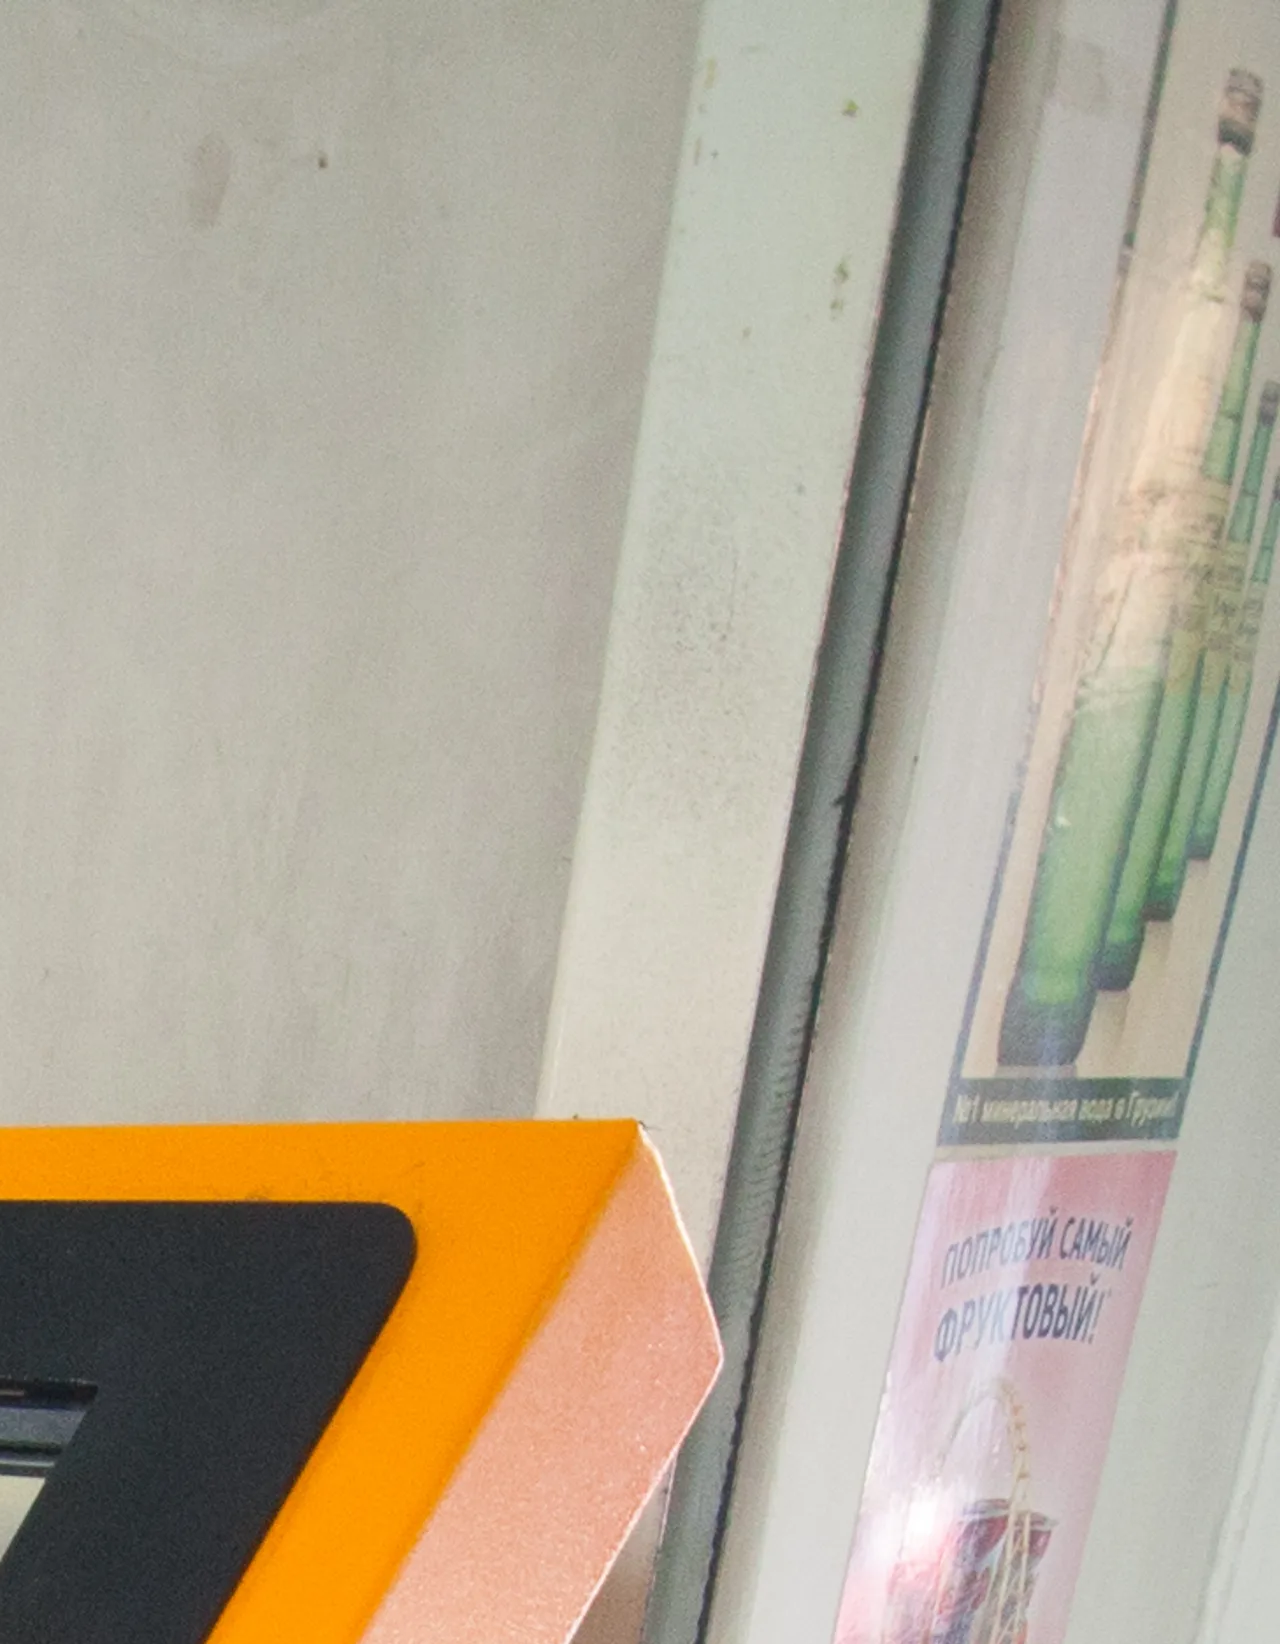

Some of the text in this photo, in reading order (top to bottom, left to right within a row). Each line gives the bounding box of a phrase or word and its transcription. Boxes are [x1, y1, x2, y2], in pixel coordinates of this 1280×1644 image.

[940, 1205, 1134, 1290] ПОПРОБУЙ САМЫЙ
[933, 1272, 1108, 1362] ФРУКТОВЫЙ!
